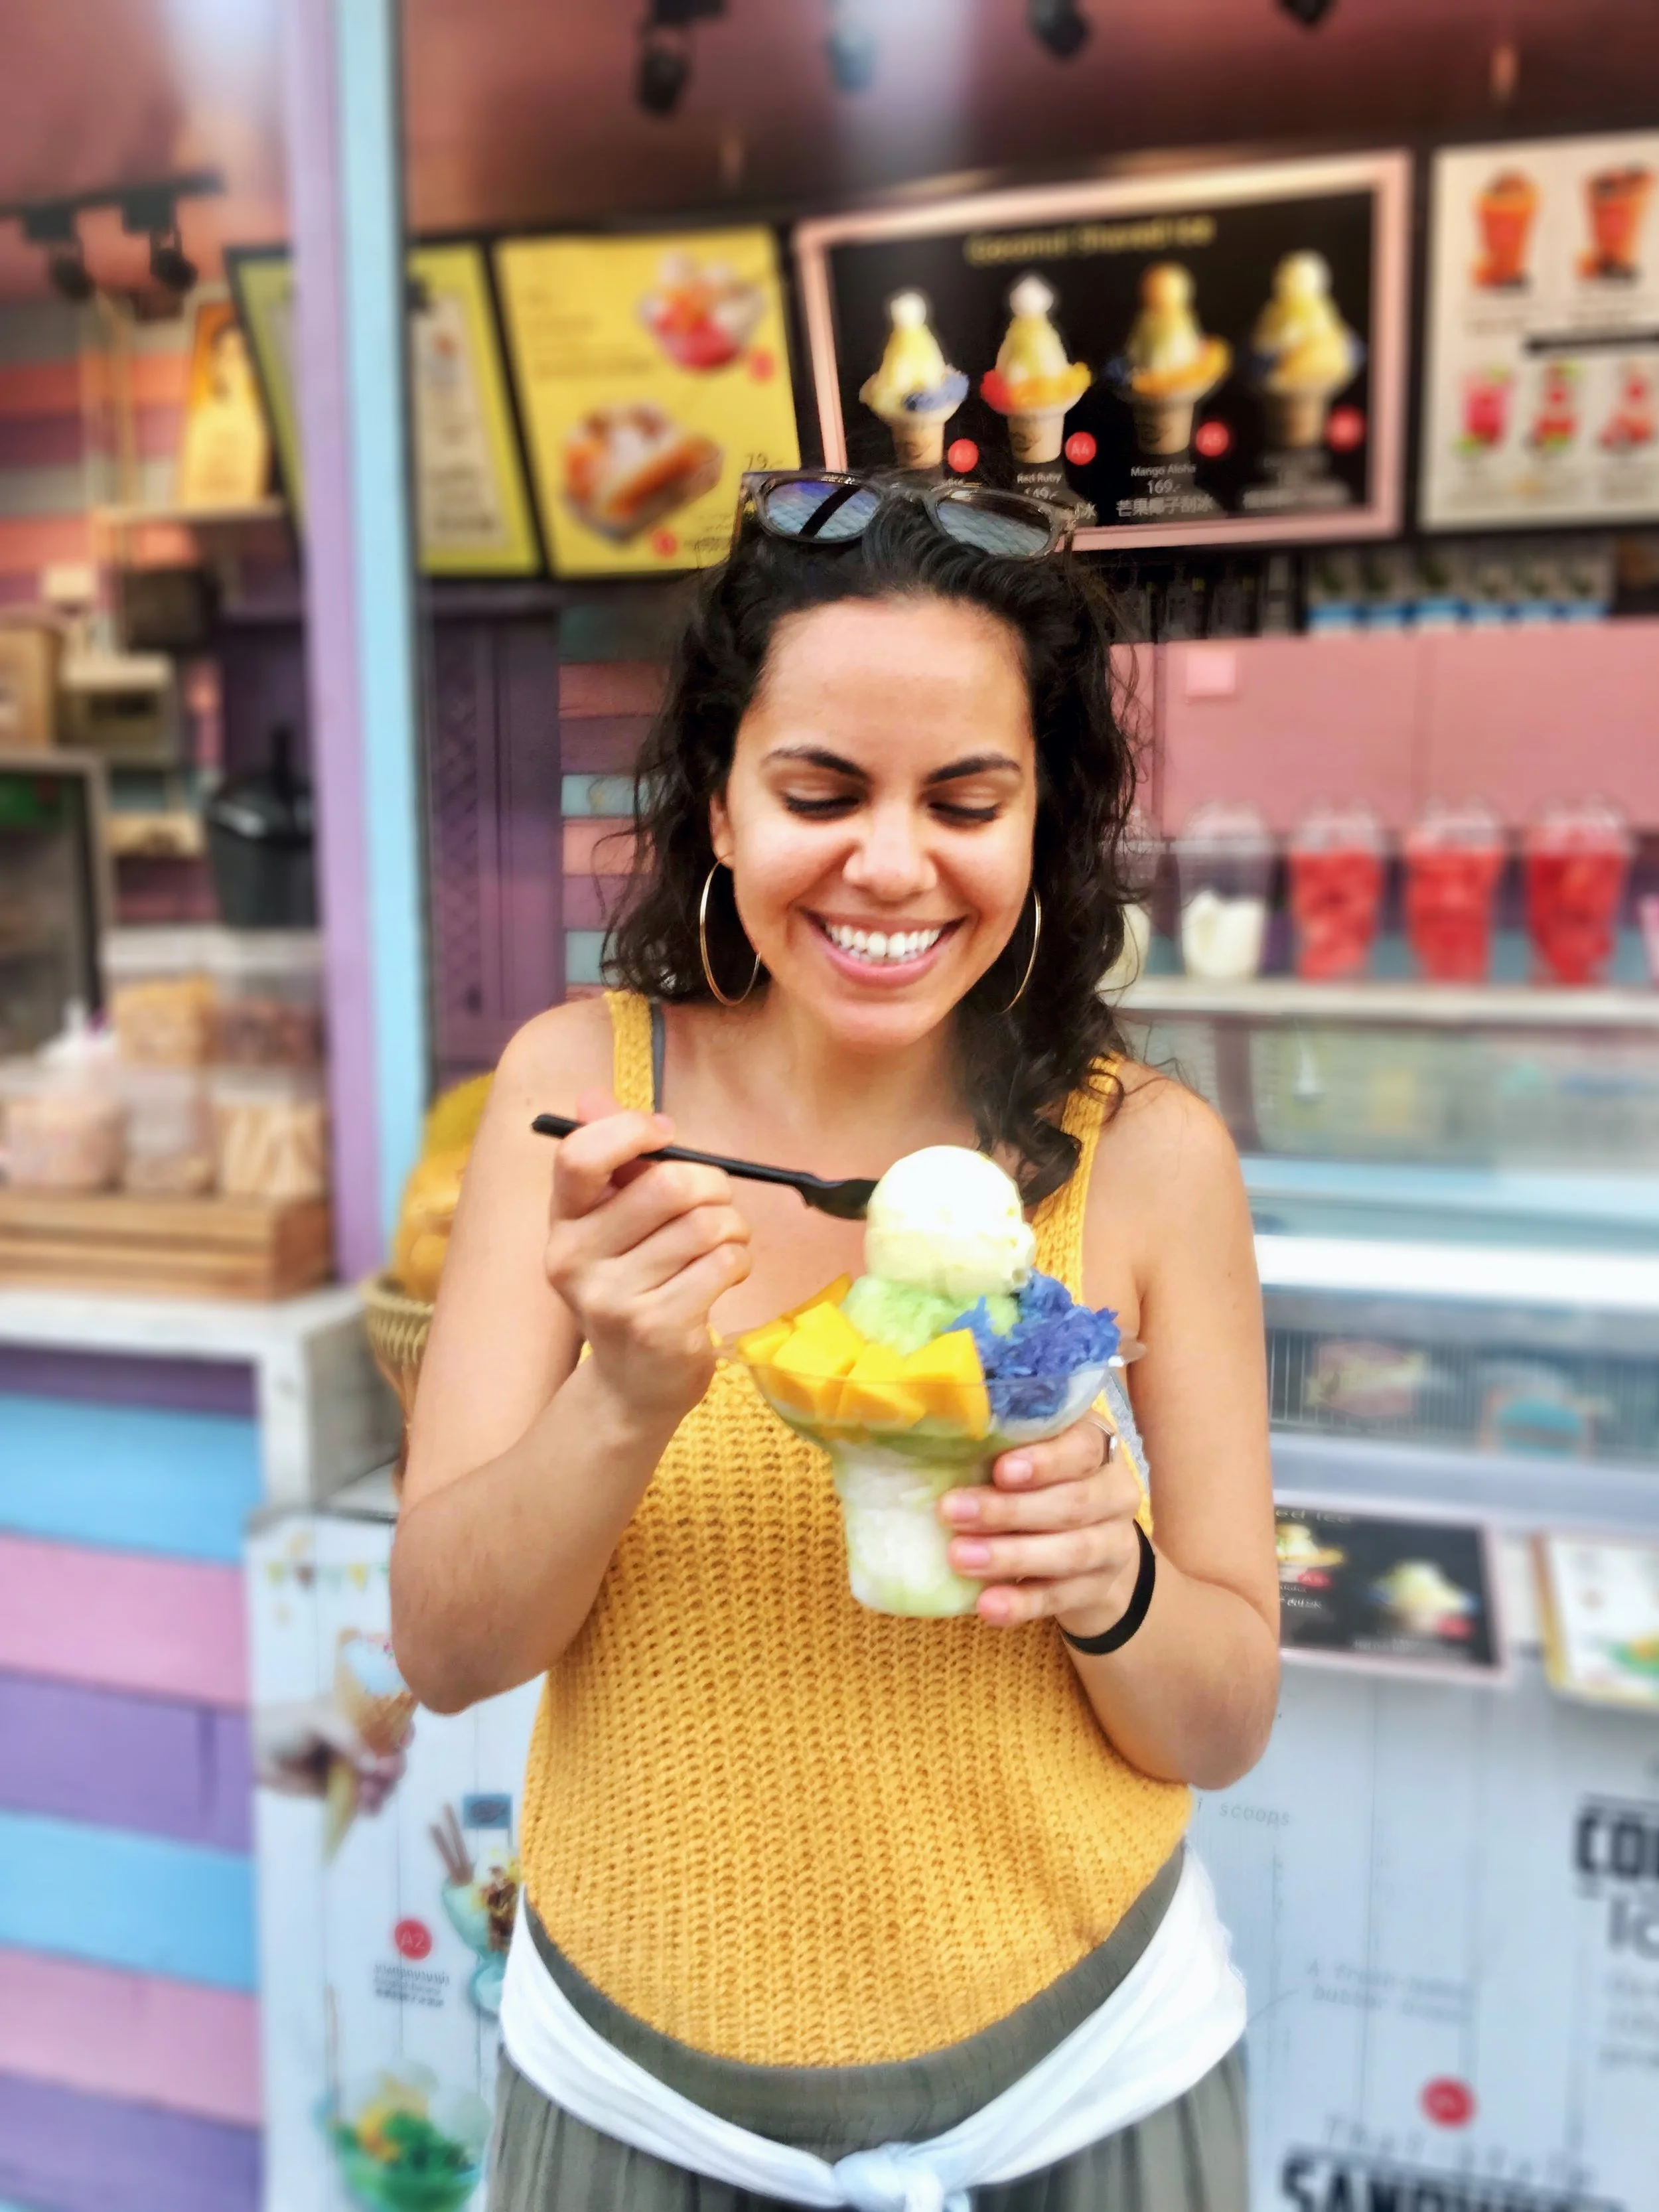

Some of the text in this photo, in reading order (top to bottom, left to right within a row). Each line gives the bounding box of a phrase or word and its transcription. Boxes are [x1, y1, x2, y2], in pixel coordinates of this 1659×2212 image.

[1071, 441, 1090, 457] A4
[1017, 472, 1062, 484] Red Ruby
[1130, 463, 1196, 477] Mango Aloha
[1219, 1802, 1291, 1830] scoops
[401, 1930, 425, 1950] A2
